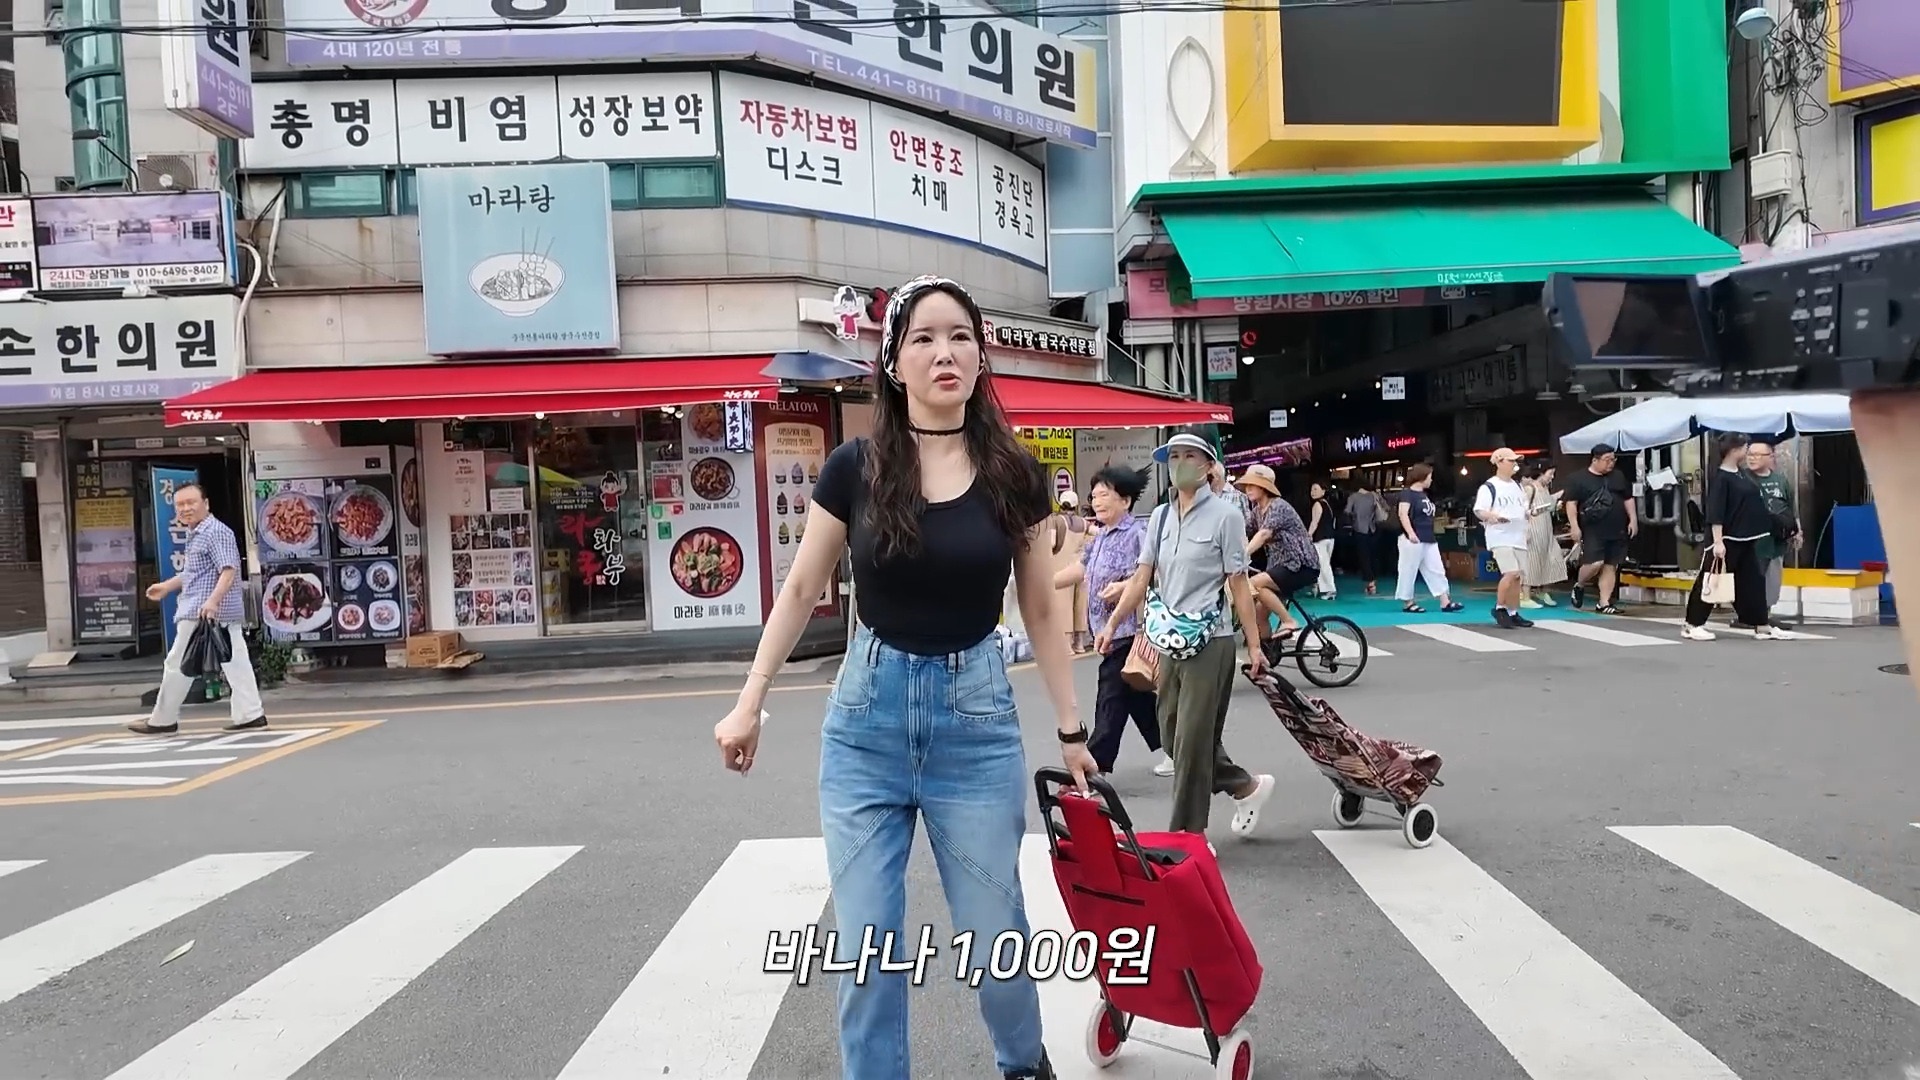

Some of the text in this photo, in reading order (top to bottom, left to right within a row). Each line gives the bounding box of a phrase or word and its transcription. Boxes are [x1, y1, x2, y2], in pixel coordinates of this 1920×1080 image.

[322, 39, 462, 58] 4대 120년 전통
[200, 63, 250, 109] 441-8111
[806, 49, 942, 103] TEL.441-8111
[217, 96, 238, 117] 2F
[569, 93, 703, 138] 성장보약
[739, 98, 859, 152] 자동차보험
[992, 104, 1013, 122] 아침
[1016, 111, 1035, 128] 8시
[766, 146, 843, 186] 디스크
[888, 128, 964, 177] 안면홍조
[467, 184, 555, 215] 마라탕
[911, 172, 948, 212] 치매
[992, 164, 1033, 208] 공진단
[994, 200, 1035, 239] 경옥고
[50, 265, 219, 280] 24시간 상담가능 010-6496-8402
[50, 386, 77, 400] 아침
[82, 384, 105, 399] 8시
[109, 382, 160, 398] 진료시작
[1043, 446, 1069, 460] 매입전문
[674, 605, 704, 619] 마라탕
